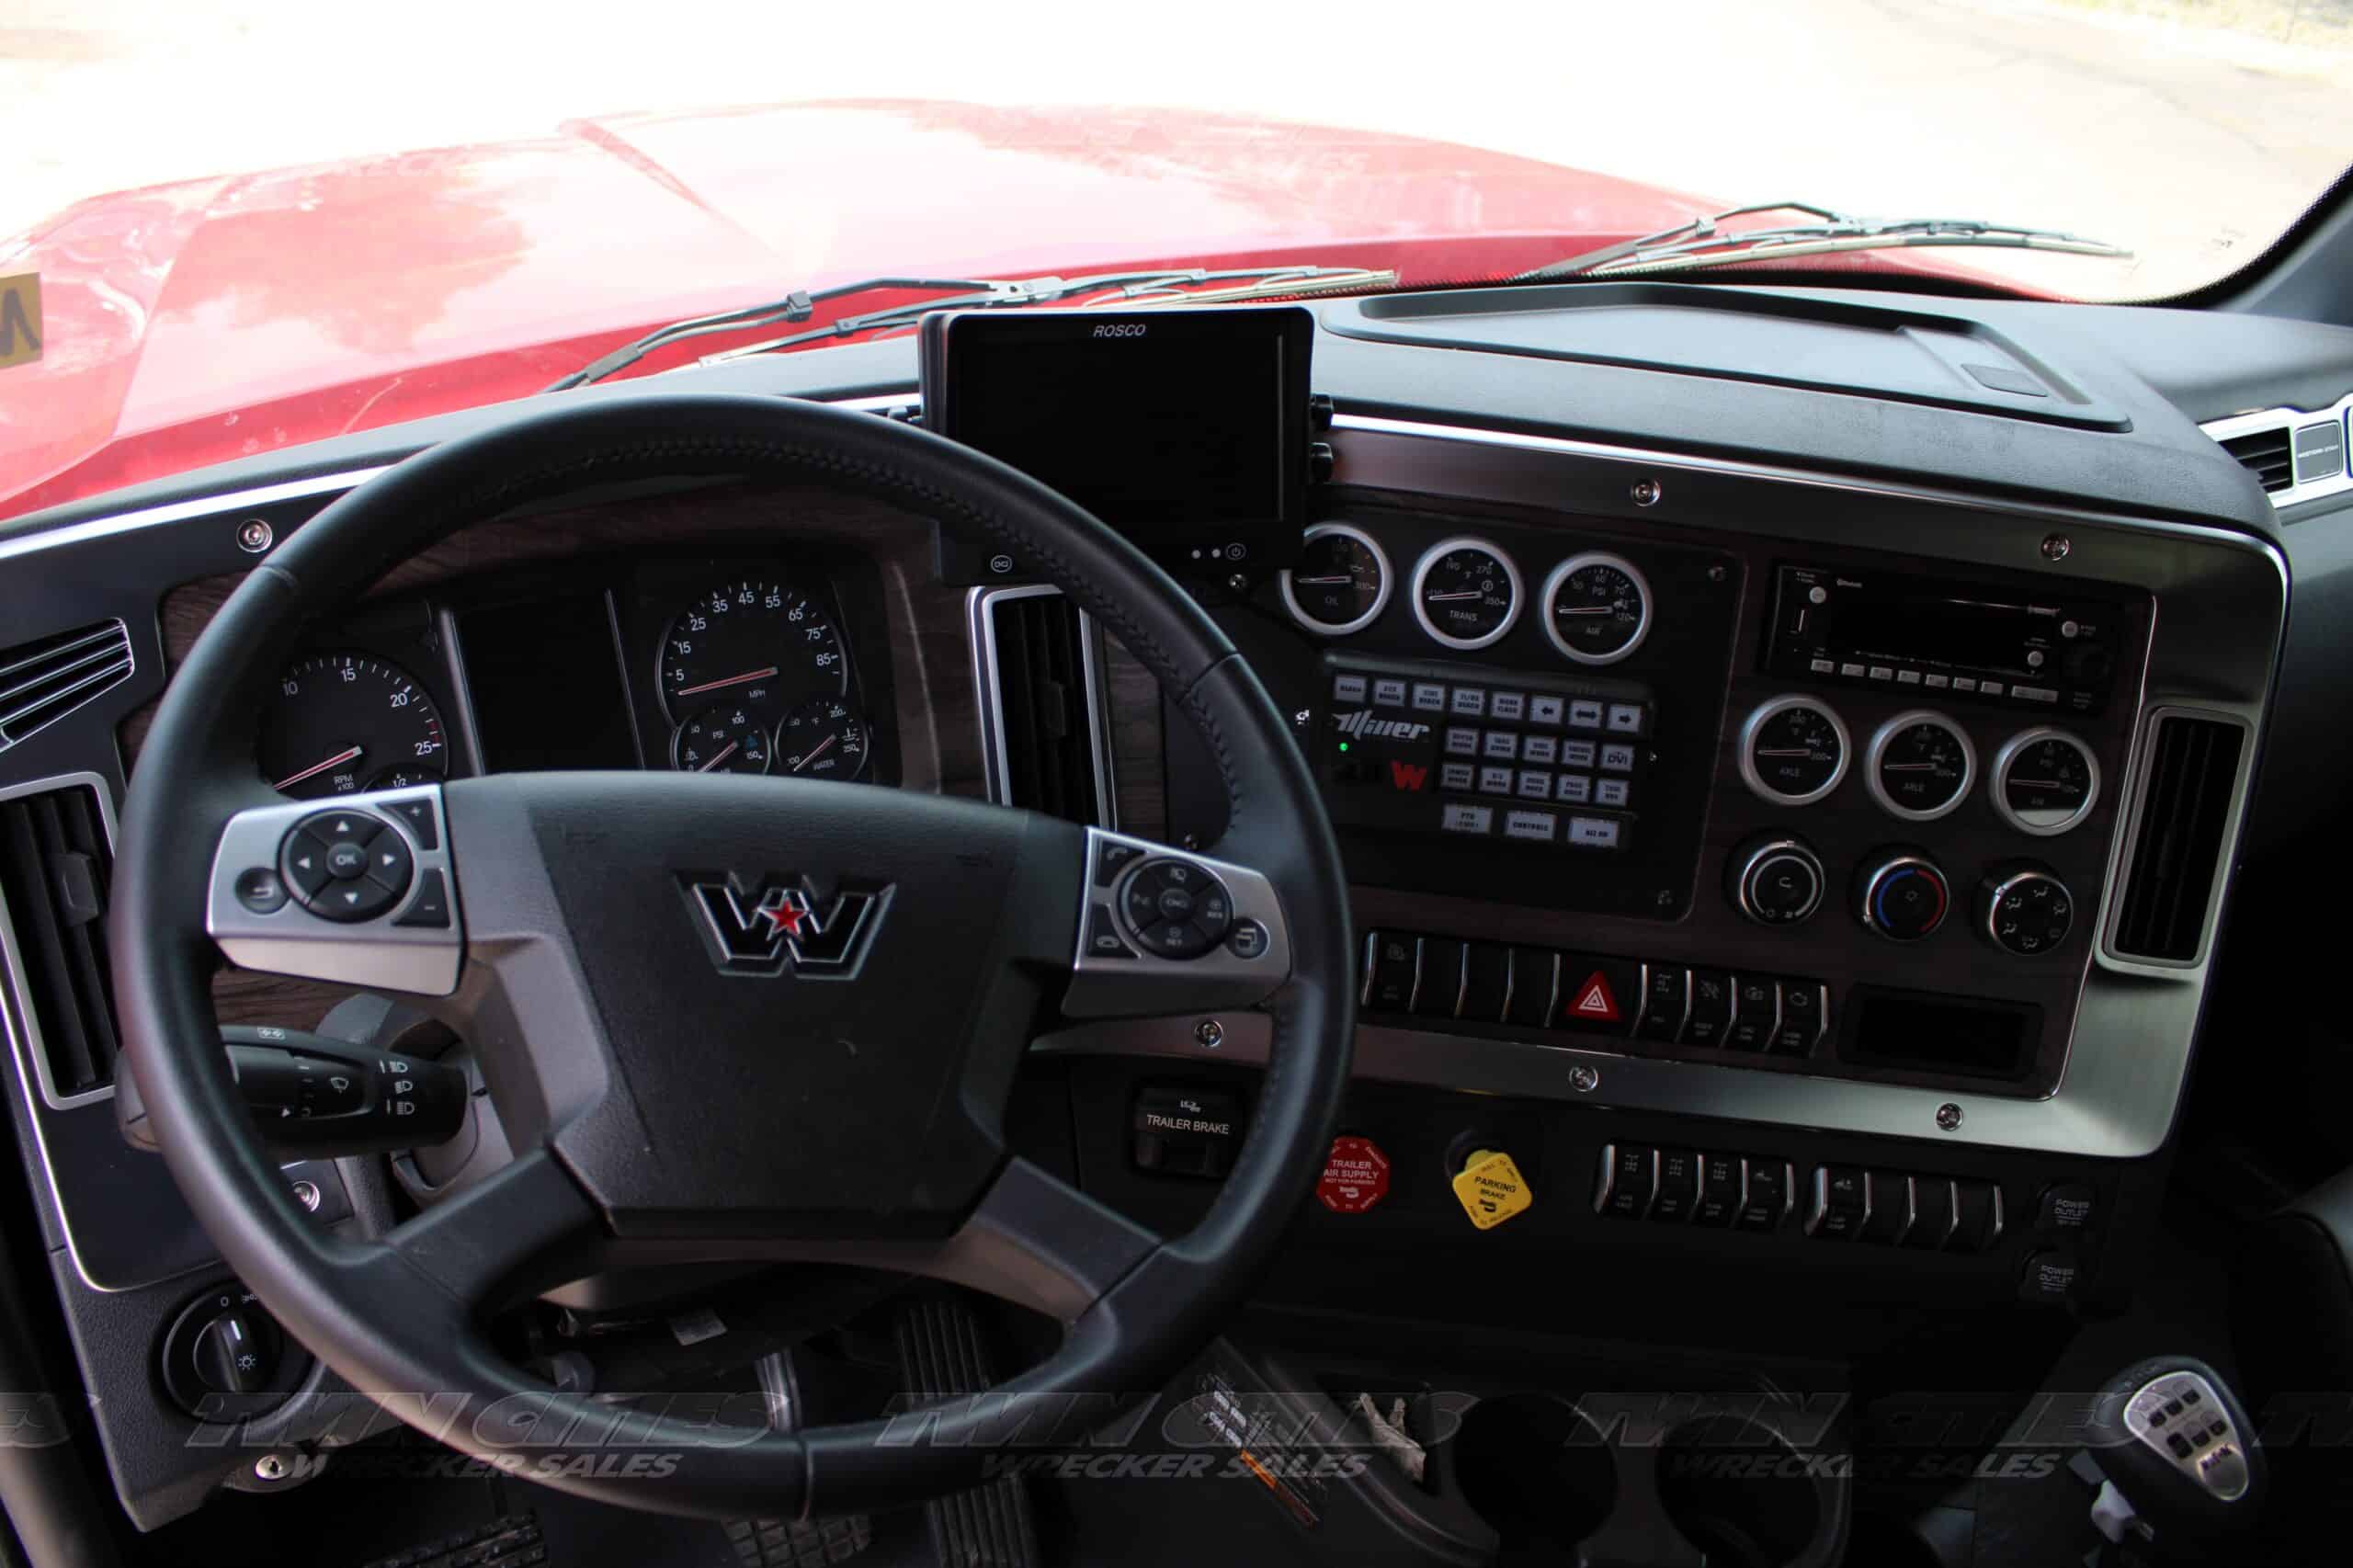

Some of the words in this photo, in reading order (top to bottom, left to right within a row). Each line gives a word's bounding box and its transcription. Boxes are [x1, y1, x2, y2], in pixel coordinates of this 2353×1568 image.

[1092, 324, 1147, 337] ROSCO
[738, 591, 755, 605] 45
[765, 594, 781, 608] 55
[712, 600, 729, 613] 35
[789, 608, 805, 622] 65
[1449, 609, 1479, 623] TRANS
[690, 617, 707, 631] 25
[805, 628, 822, 641] 75
[676, 641, 692, 654] 15
[816, 654, 832, 667] 85
[341, 668, 357, 682] 15
[676, 669, 685, 681] 5
[283, 681, 299, 697] 10
[390, 693, 408, 707] 20
[415, 742, 433, 756] 25
[335, 854, 358, 866] OK
[1146, 1114, 1191, 1130] TRAILER
[1193, 1120, 1230, 1134] BRAKE
[1331, 1160, 1372, 1170] TRAILER
[1324, 1168, 1339, 1177] AIR
[1341, 1169, 1379, 1180] SUPPLY
[1474, 1176, 1517, 1193] PARKING
[1480, 1188, 1506, 1200] BRAKE
